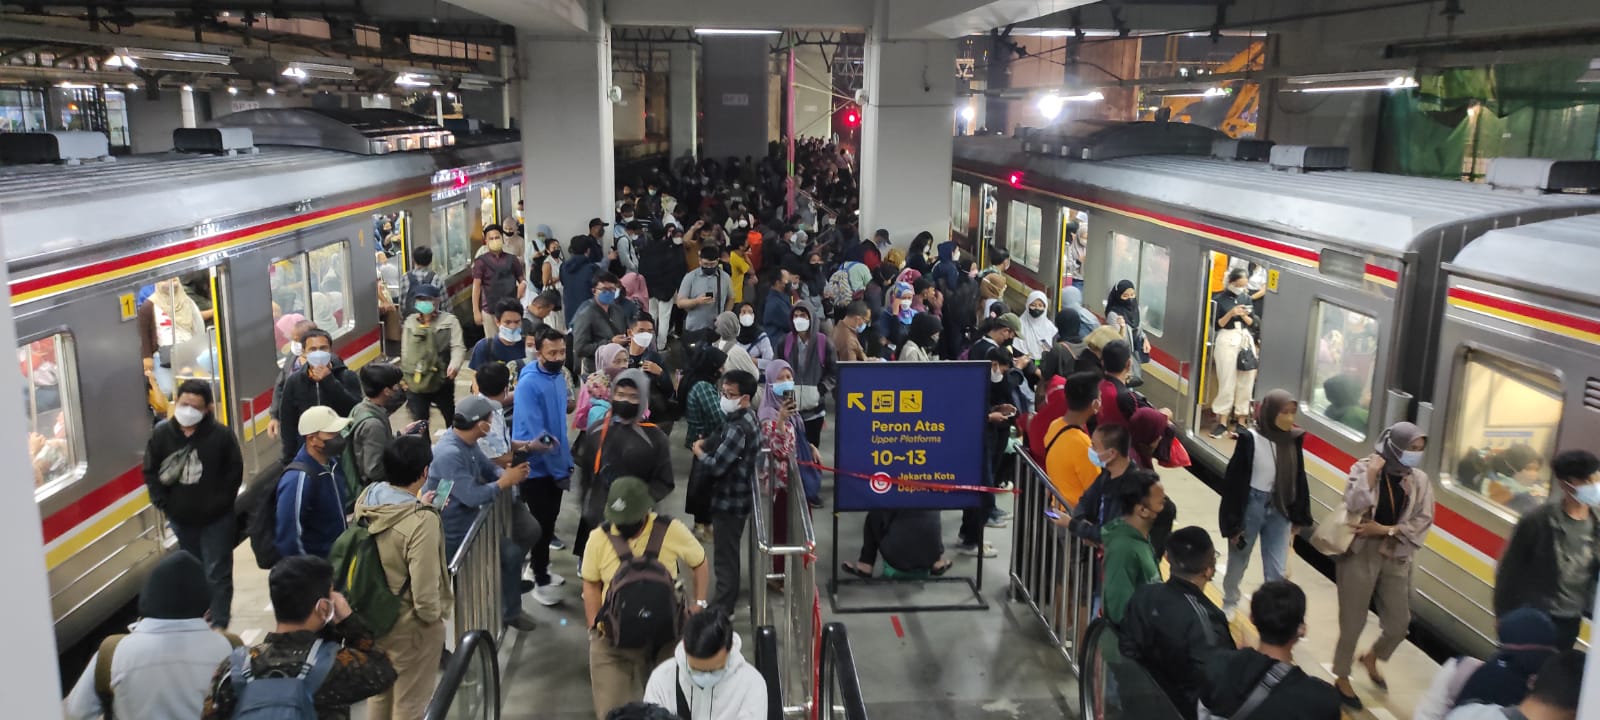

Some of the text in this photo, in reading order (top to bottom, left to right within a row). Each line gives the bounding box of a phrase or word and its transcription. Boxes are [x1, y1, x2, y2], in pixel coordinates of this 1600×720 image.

[872, 420, 945, 432] Peron Atas
[871, 434, 942, 444] Upper Platforms
[872, 450, 926, 465] 10~13
[898, 471, 956, 481] Jakarta Kota
